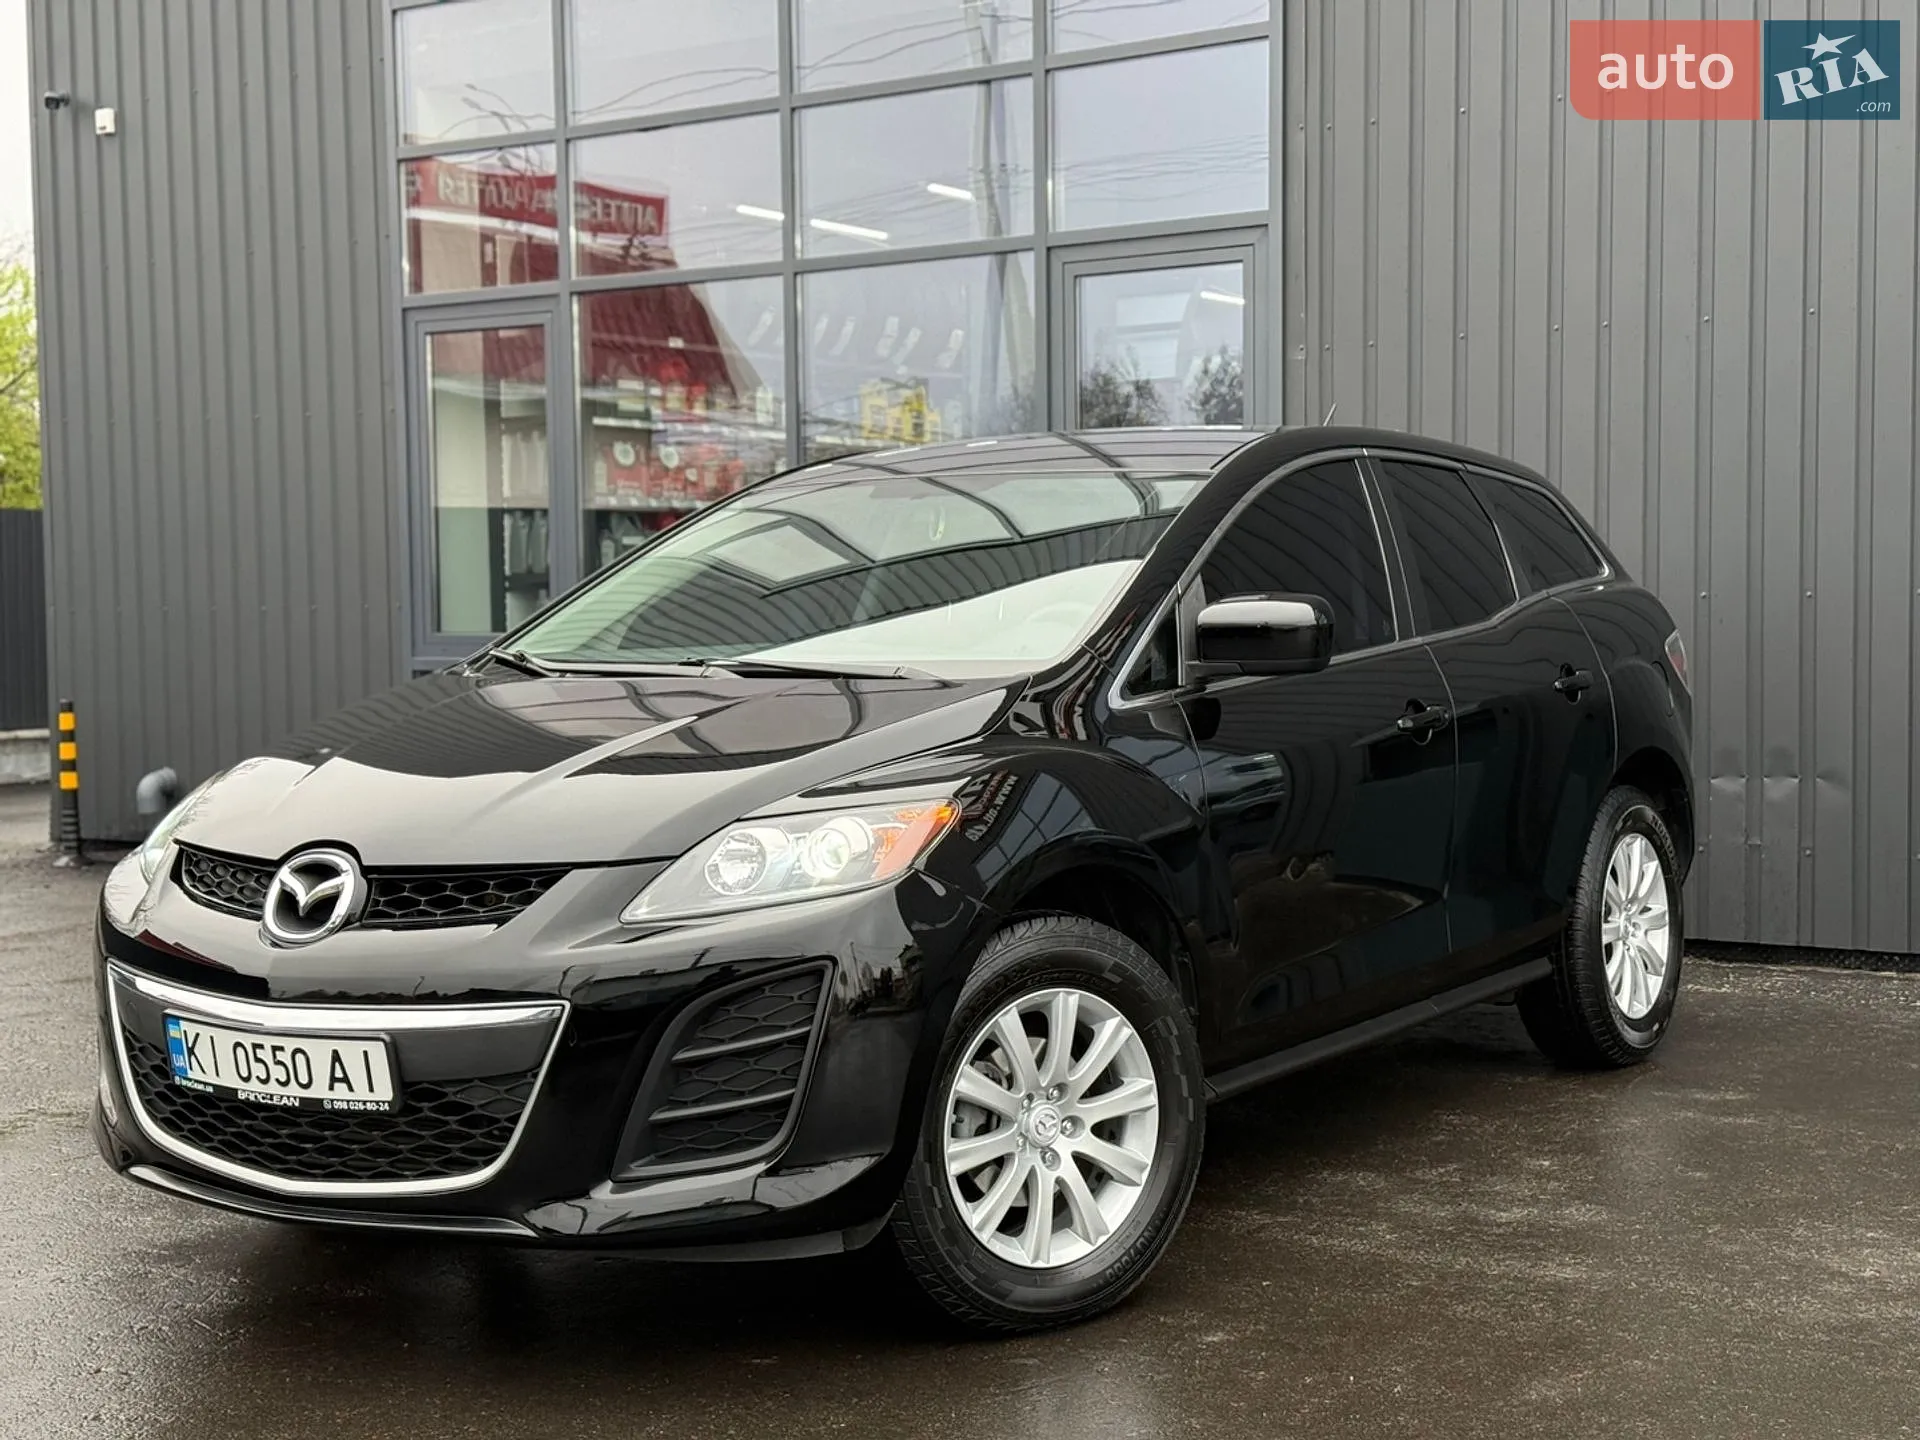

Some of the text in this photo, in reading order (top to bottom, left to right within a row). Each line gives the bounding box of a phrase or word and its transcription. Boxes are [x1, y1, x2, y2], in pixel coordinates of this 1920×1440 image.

[173, 1054, 186, 1069] UA
[183, 1029, 374, 1093] KI 0550 AI
[333, 1100, 348, 1110] 098
